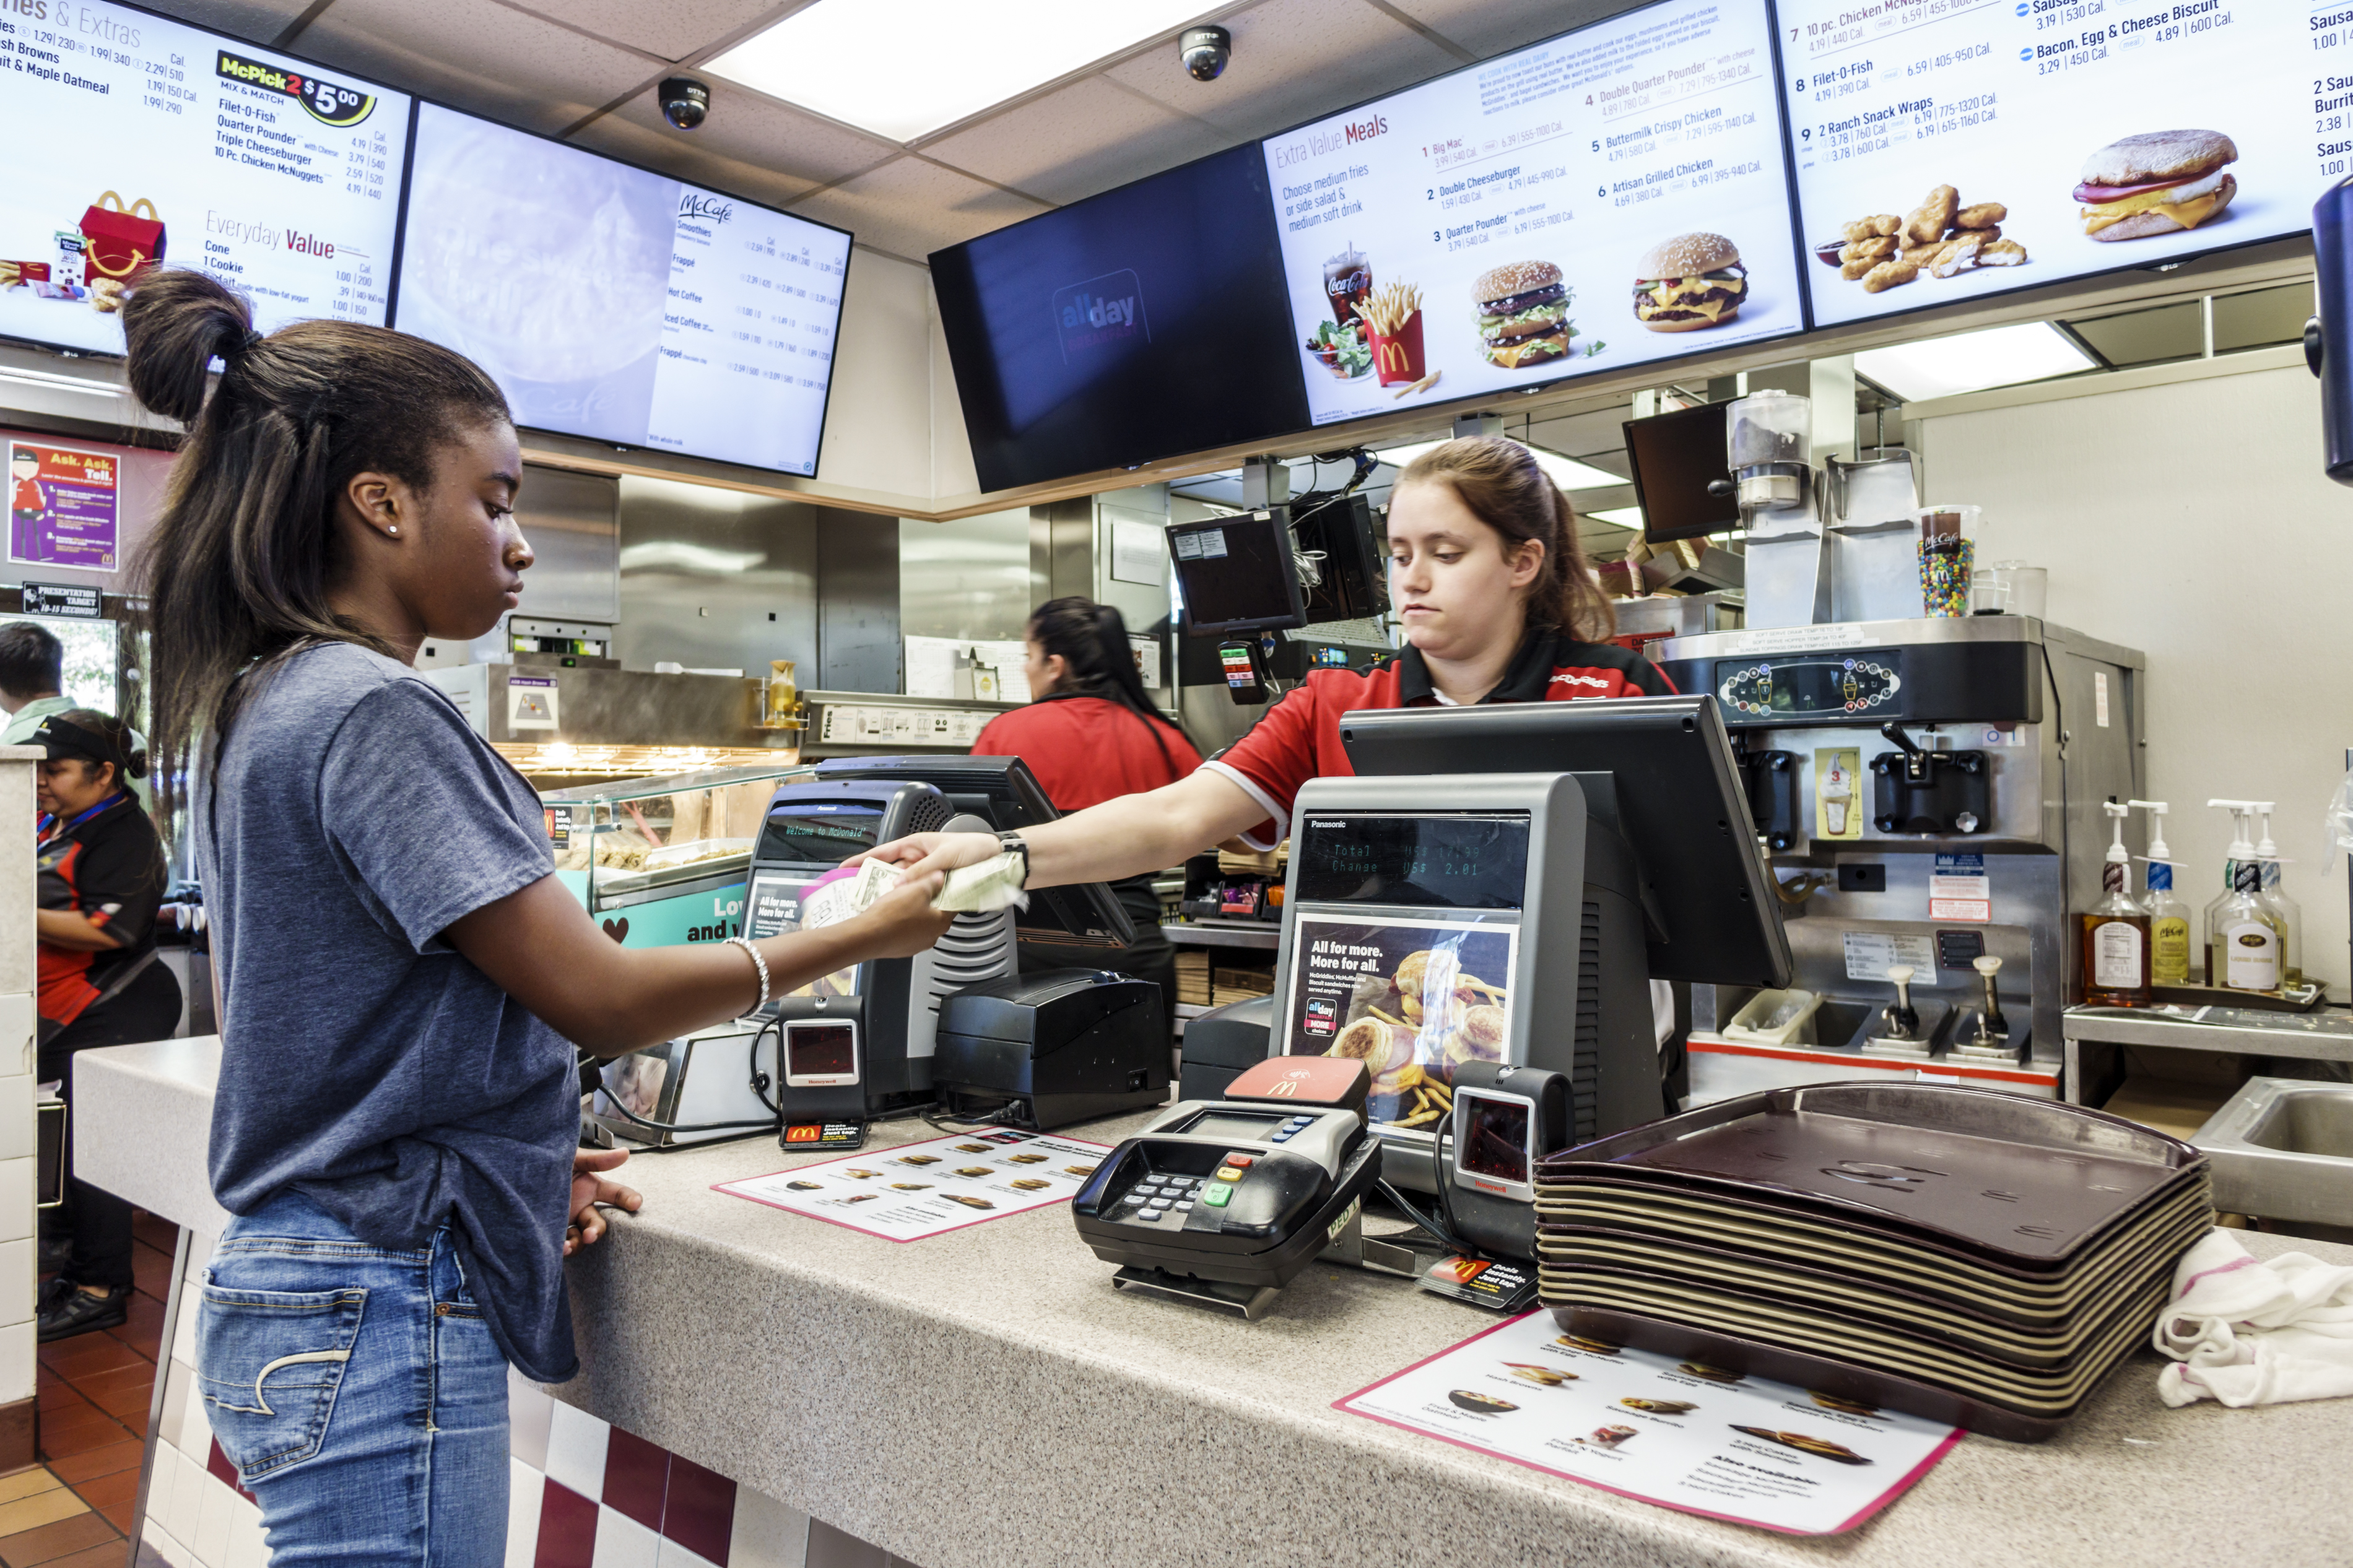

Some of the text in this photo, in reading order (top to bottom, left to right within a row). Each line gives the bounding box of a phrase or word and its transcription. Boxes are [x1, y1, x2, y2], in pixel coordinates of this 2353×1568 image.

[80, 7, 141, 48] Extras
[2214, 11, 2234, 27] Cal.
[2037, 0, 2219, 58] Bacon, Egg & Cheese Biscuit
[18, 42, 59, 64] Browns
[2092, 45, 2110, 61] Cal.
[27, 62, 109, 95] Maple Oatmeal
[1813, 59, 1873, 87] Filet-O-Fish
[220, 80, 284, 105] MIX MATCH
[1829, 97, 1933, 135] Ranch Snack Wraps
[218, 115, 254, 134] Quarter
[257, 126, 297, 145] Pounder
[318, 146, 339, 157] Cheese
[1606, 107, 1722, 148] Buttermilk Crispy Chicken
[374, 131, 387, 142] Cal.
[1276, 114, 1388, 169] Extra Value Meals
[216, 130, 311, 165] Triple Cheeseburger
[1433, 137, 1463, 155] Big Mac
[241, 154, 324, 183] Chicken McNuggets
[1613, 159, 1713, 194] Artisan Grilled Chicken
[1283, 165, 1369, 201] Choose medium fries
[1440, 166, 1521, 196] Double Cheeseburger
[1286, 190, 1337, 216] or side salad
[1289, 199, 1363, 233] medium soft drink
[1446, 202, 1546, 240] Quarter Pounder with cheese
[207, 210, 334, 259] Everyday Value
[677, 220, 711, 238] Smoothies
[206, 240, 230, 255] Cone
[211, 258, 243, 274] Cookie
[255, 285, 268, 294] with
[668, 287, 703, 303] Hot Coffee
[664, 313, 702, 329] Iced Coffee
[51, 453, 113, 470] Ask. Ask.
[85, 469, 113, 482] Tell.
[38, 586, 96, 597] PRESENTATION
[66, 597, 96, 605] TARGET
[40, 605, 98, 615] 10-15 SECONDS!
[824, 711, 833, 739] Fries
[786, 826, 814, 836] Welcome
[818, 826, 825, 836] to
[1335, 844, 1370, 857] Total
[1440, 847, 1479, 858] 17.99
[1333, 860, 1377, 873] Change
[1445, 863, 1477, 875] 2.01
[688, 920, 726, 942] and
[1311, 941, 1383, 957] All for more.
[1310, 955, 1379, 972] More for all.
[1310, 1020, 1329, 1029] MORE
[1475, 1180, 1507, 1193] Honeywell
[1331, 1209, 1349, 1235] PED
[1485, 1268, 1526, 1283] instantly.
[1493, 1264, 1519, 1273] Deals
[1478, 1275, 1516, 1288] Just tap.
[1544, 1343, 1583, 1357] Sausage
[1559, 1350, 1577, 1358] Egg
[1485, 1374, 1542, 1392] Hash Browns
[1421, 1406, 1461, 1420] Oatmeal
[1428, 1403, 1487, 1423] Fruit Maple
[1606, 1405, 1684, 1429] Sausage Burrito
[1591, 1449, 1623, 1462] Yogurt
